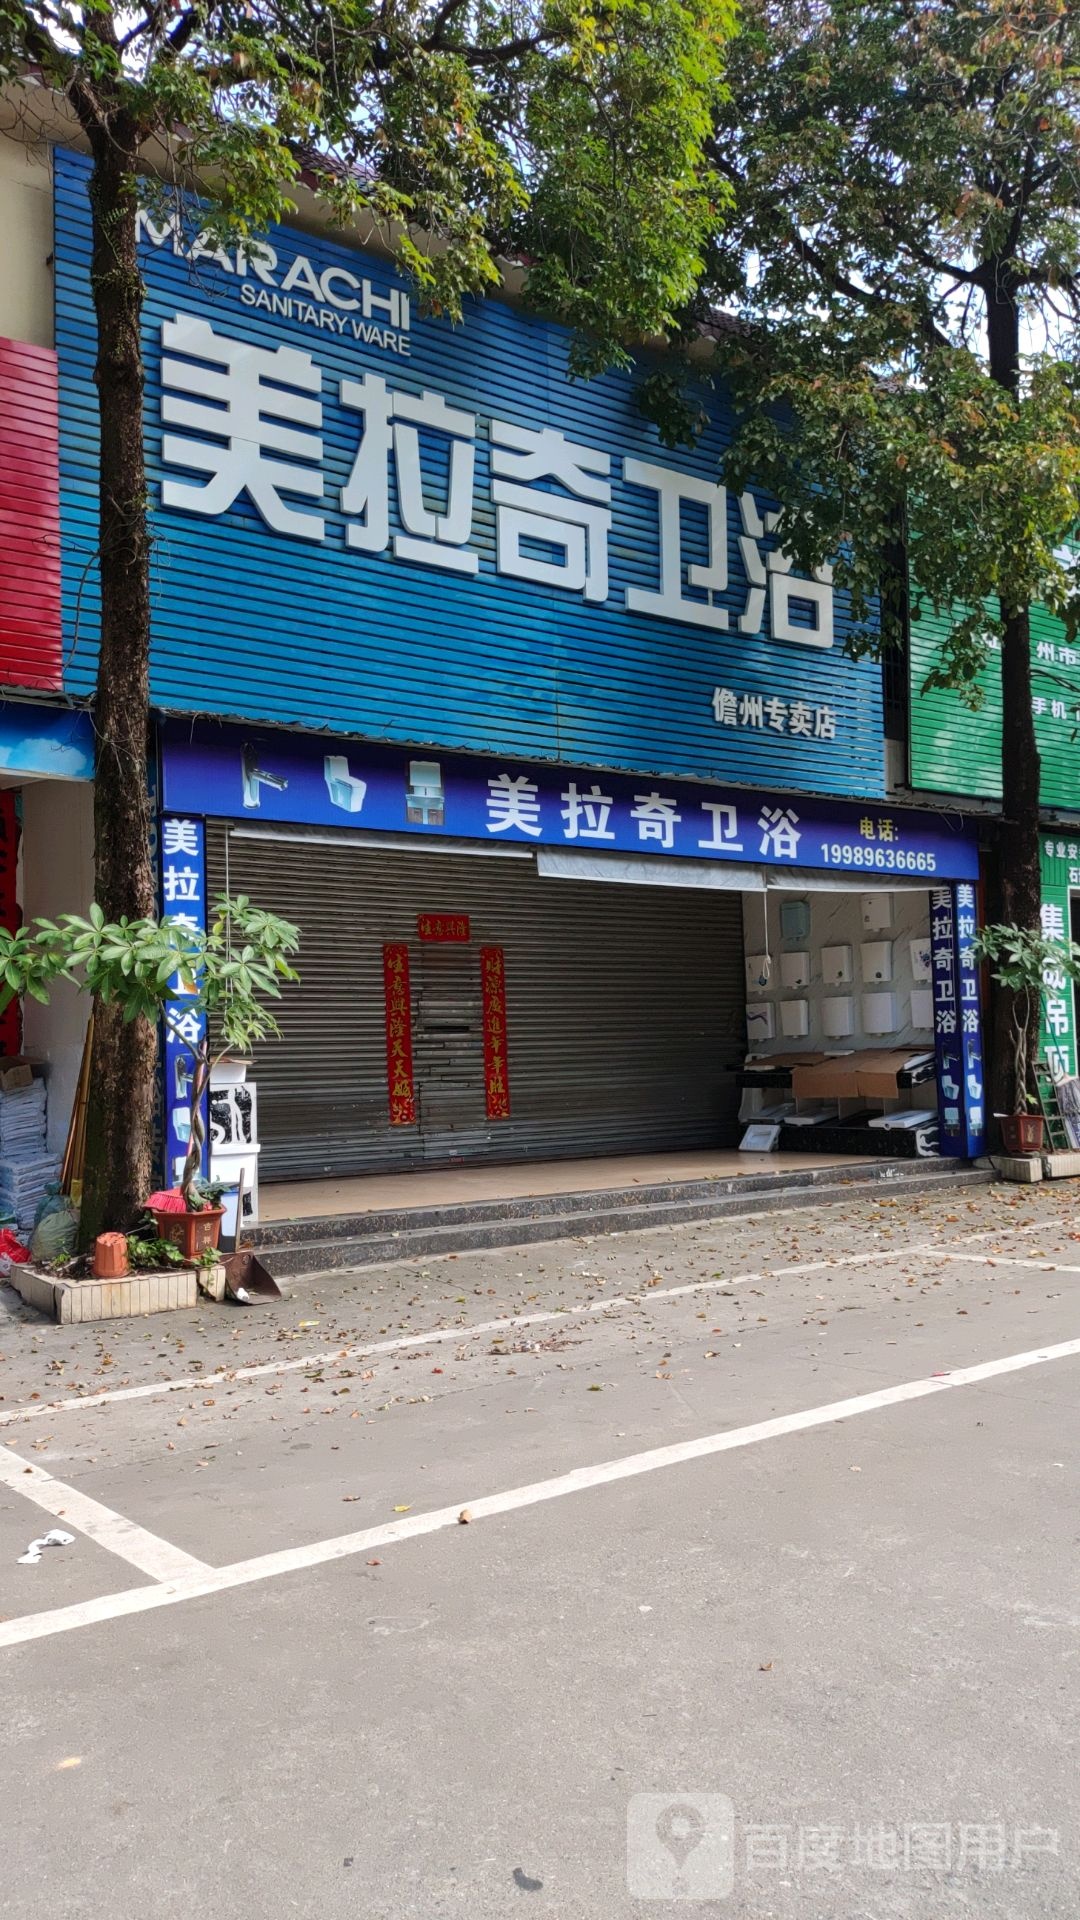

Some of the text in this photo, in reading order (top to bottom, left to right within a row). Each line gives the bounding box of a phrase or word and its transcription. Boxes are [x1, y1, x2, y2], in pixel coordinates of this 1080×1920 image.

[134, 207, 411, 332] MARACHI
[240, 283, 412, 358] SANITARY WARE
[711, 686, 837, 741] 儋州专卖店
[1031, 696, 1080, 721] 手机
[485, 773, 802, 859] 美拉奇卫浴
[1044, 839, 1080, 860] 专业安
[820, 843, 937, 873] 19989636665
[1068, 866, 1080, 883] 石
[163, 817, 203, 1045] 美拉浴
[932, 889, 957, 1034] 美拉奇卫浴
[956, 883, 980, 1034] 美拉奇卫浴
